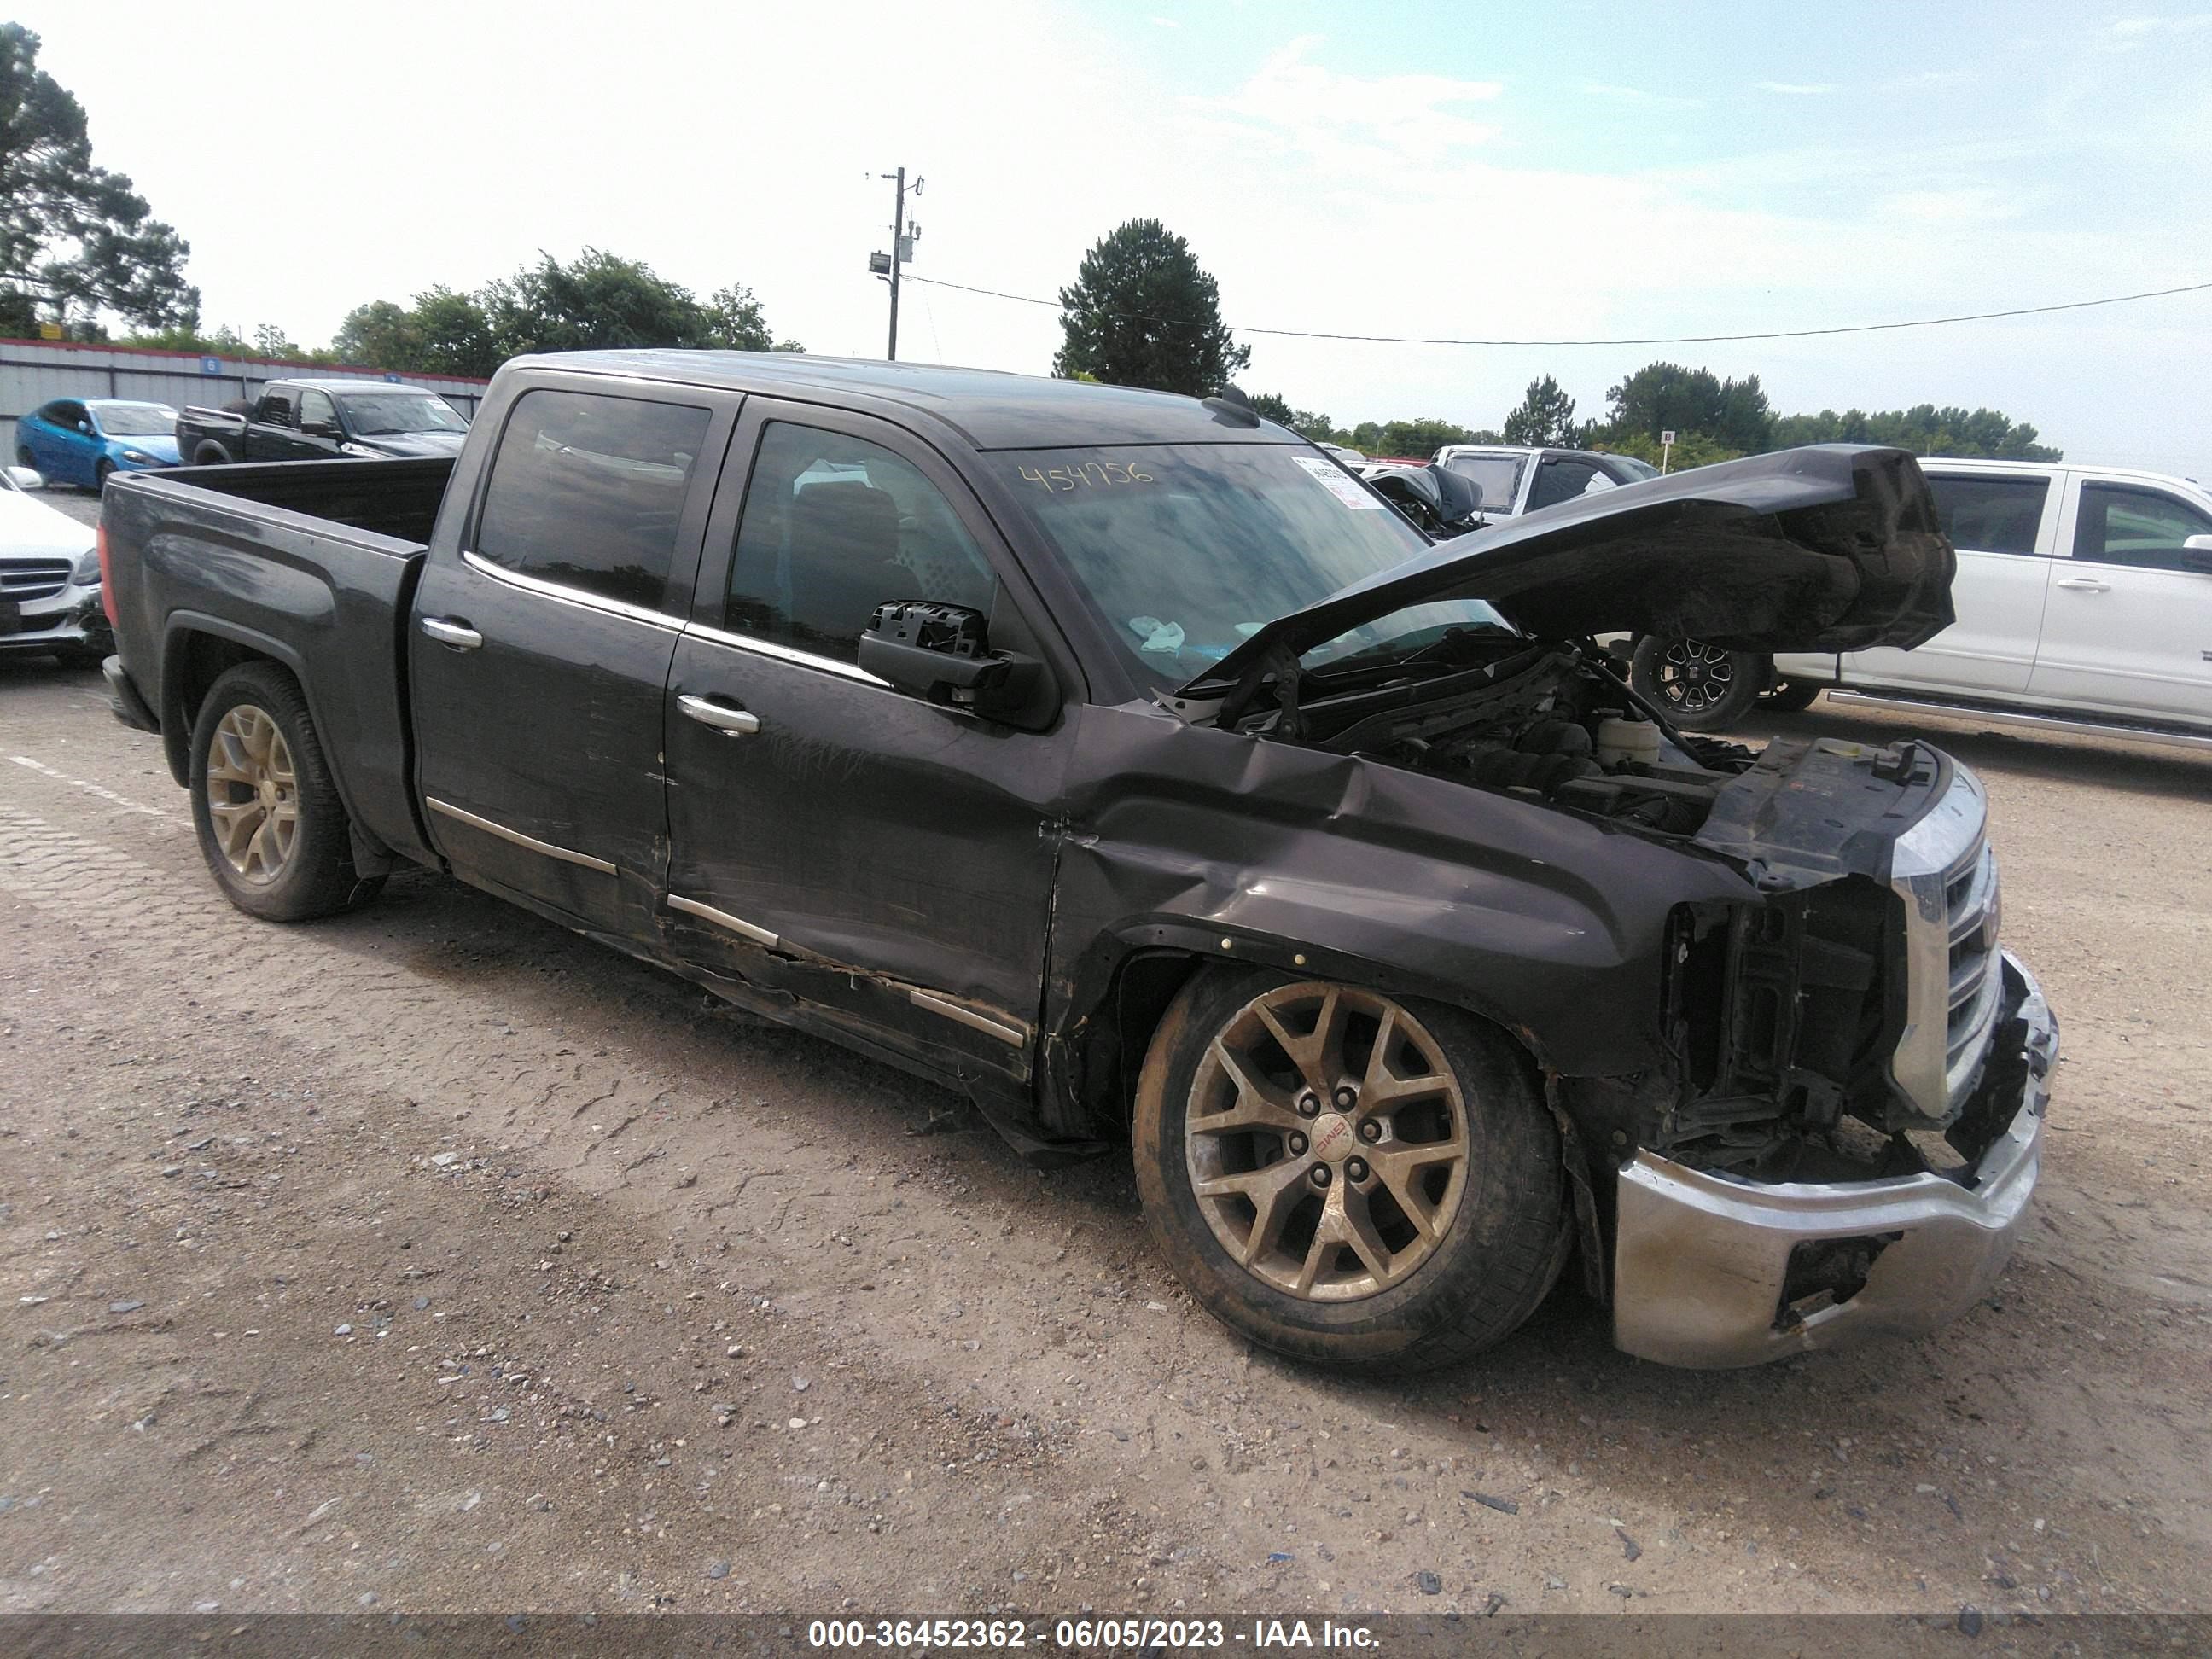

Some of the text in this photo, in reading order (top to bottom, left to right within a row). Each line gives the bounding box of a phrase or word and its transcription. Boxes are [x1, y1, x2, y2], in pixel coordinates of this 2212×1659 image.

[207, 359, 216, 370] 6
[1664, 432, 1673, 442] B
[1018, 463, 1154, 493] 454756
[1317, 1121, 1346, 1153] GMC
